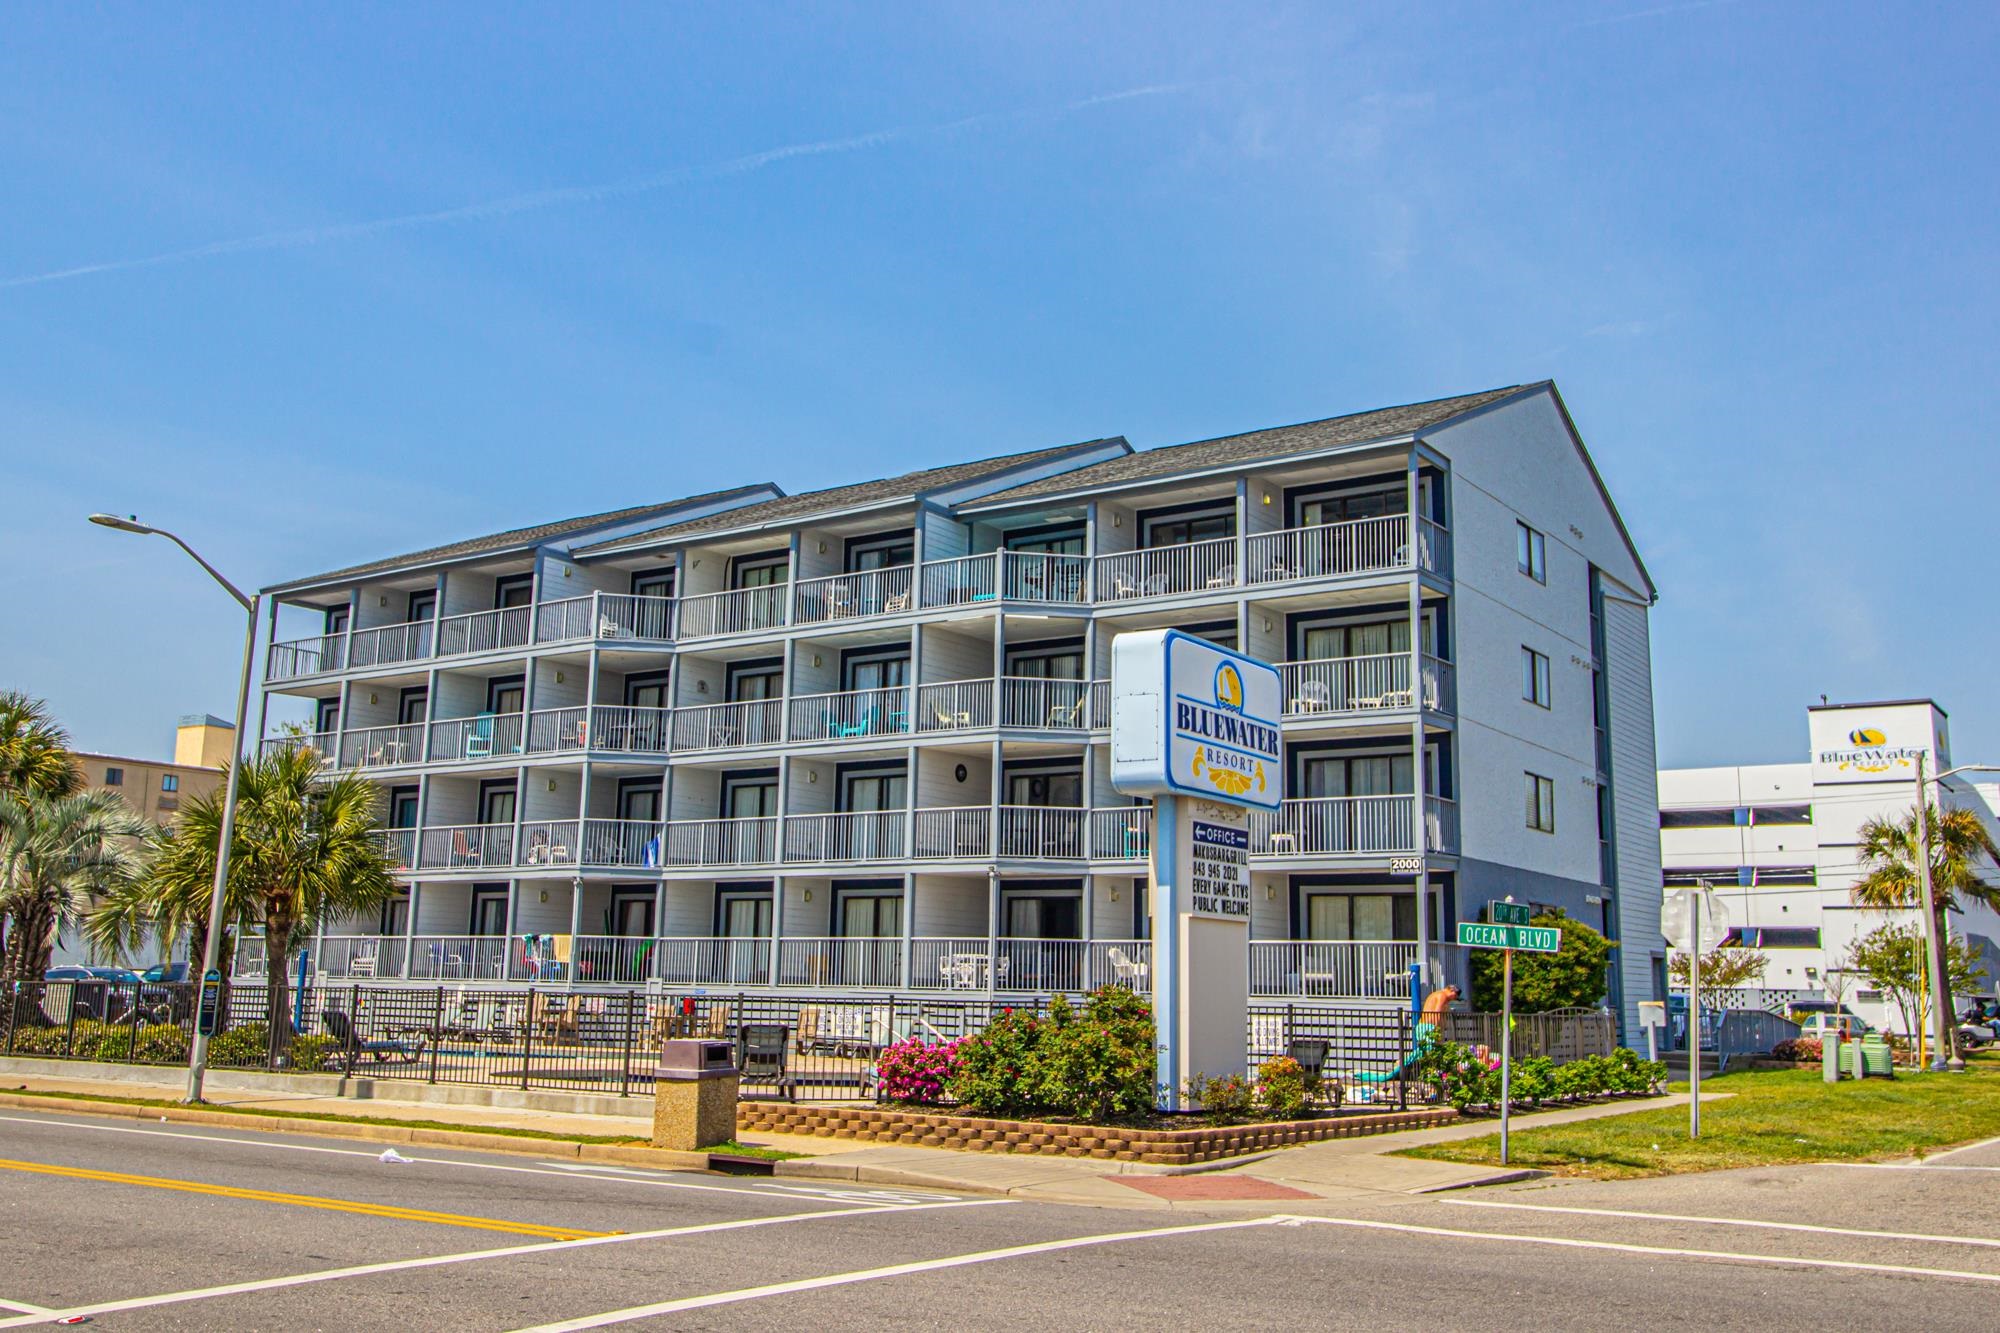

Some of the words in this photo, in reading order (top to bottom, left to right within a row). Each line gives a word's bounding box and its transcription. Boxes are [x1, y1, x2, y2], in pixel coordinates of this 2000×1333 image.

[1177, 702, 1278, 756] BLUEWATER
[1207, 748, 1254, 772] RESORT
[1206, 828, 1235, 845] OFFICE
[1193, 861, 1205, 876] 843
[1208, 863, 1220, 879] 945
[1223, 866, 1238, 881] 2021
[1392, 859, 1420, 869] 2000
[1193, 878, 1211, 895] EVERY
[1213, 881, 1230, 897] GAME
[1193, 896, 1218, 913] PUBLIC
[1221, 899, 1249, 916] WELCOME
[1466, 926, 1507, 945] OCEAN
[1520, 930, 1551, 948] BLVD
